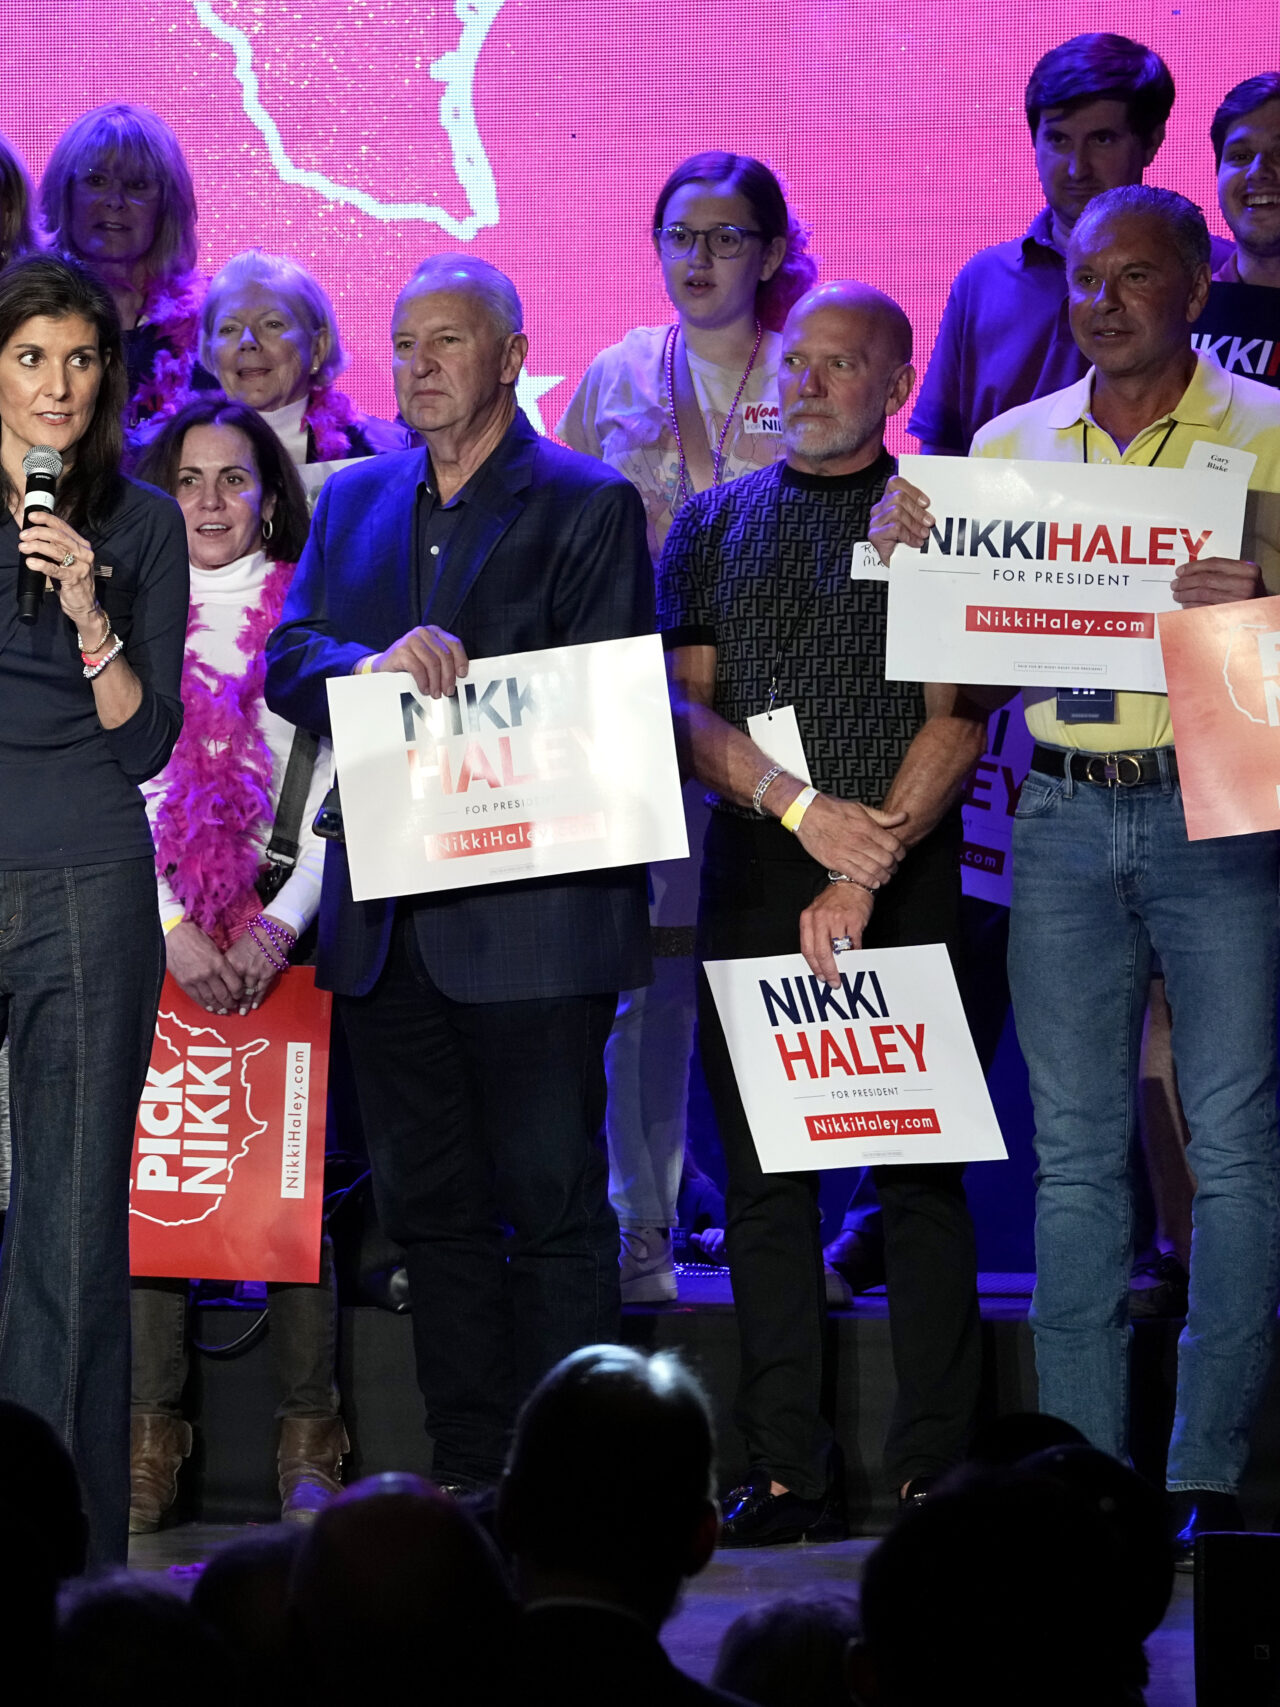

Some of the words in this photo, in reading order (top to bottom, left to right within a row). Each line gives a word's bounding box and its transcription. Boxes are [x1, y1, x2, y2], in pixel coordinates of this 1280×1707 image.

[1206, 461, 1228, 473] Blake
[1210, 454, 1230, 464] Gary
[993, 569, 1025, 582] FOR
[1035, 573, 1130, 586] PRESIDENT
[976, 610, 1146, 634] NikkiHaley.com
[465, 804, 488, 815] FOR
[759, 970, 890, 1027] NIKKI
[774, 1023, 927, 1081] HALEY
[831, 1090, 849, 1100] FOR
[852, 1087, 899, 1097] PRESIDENT
[136, 1062, 184, 1192] PICK
[181, 1045, 232, 1194] NIKKI
[286, 1050, 306, 1189] NikkiHaley.com
[813, 1117, 933, 1136] NikkiHaley.com
